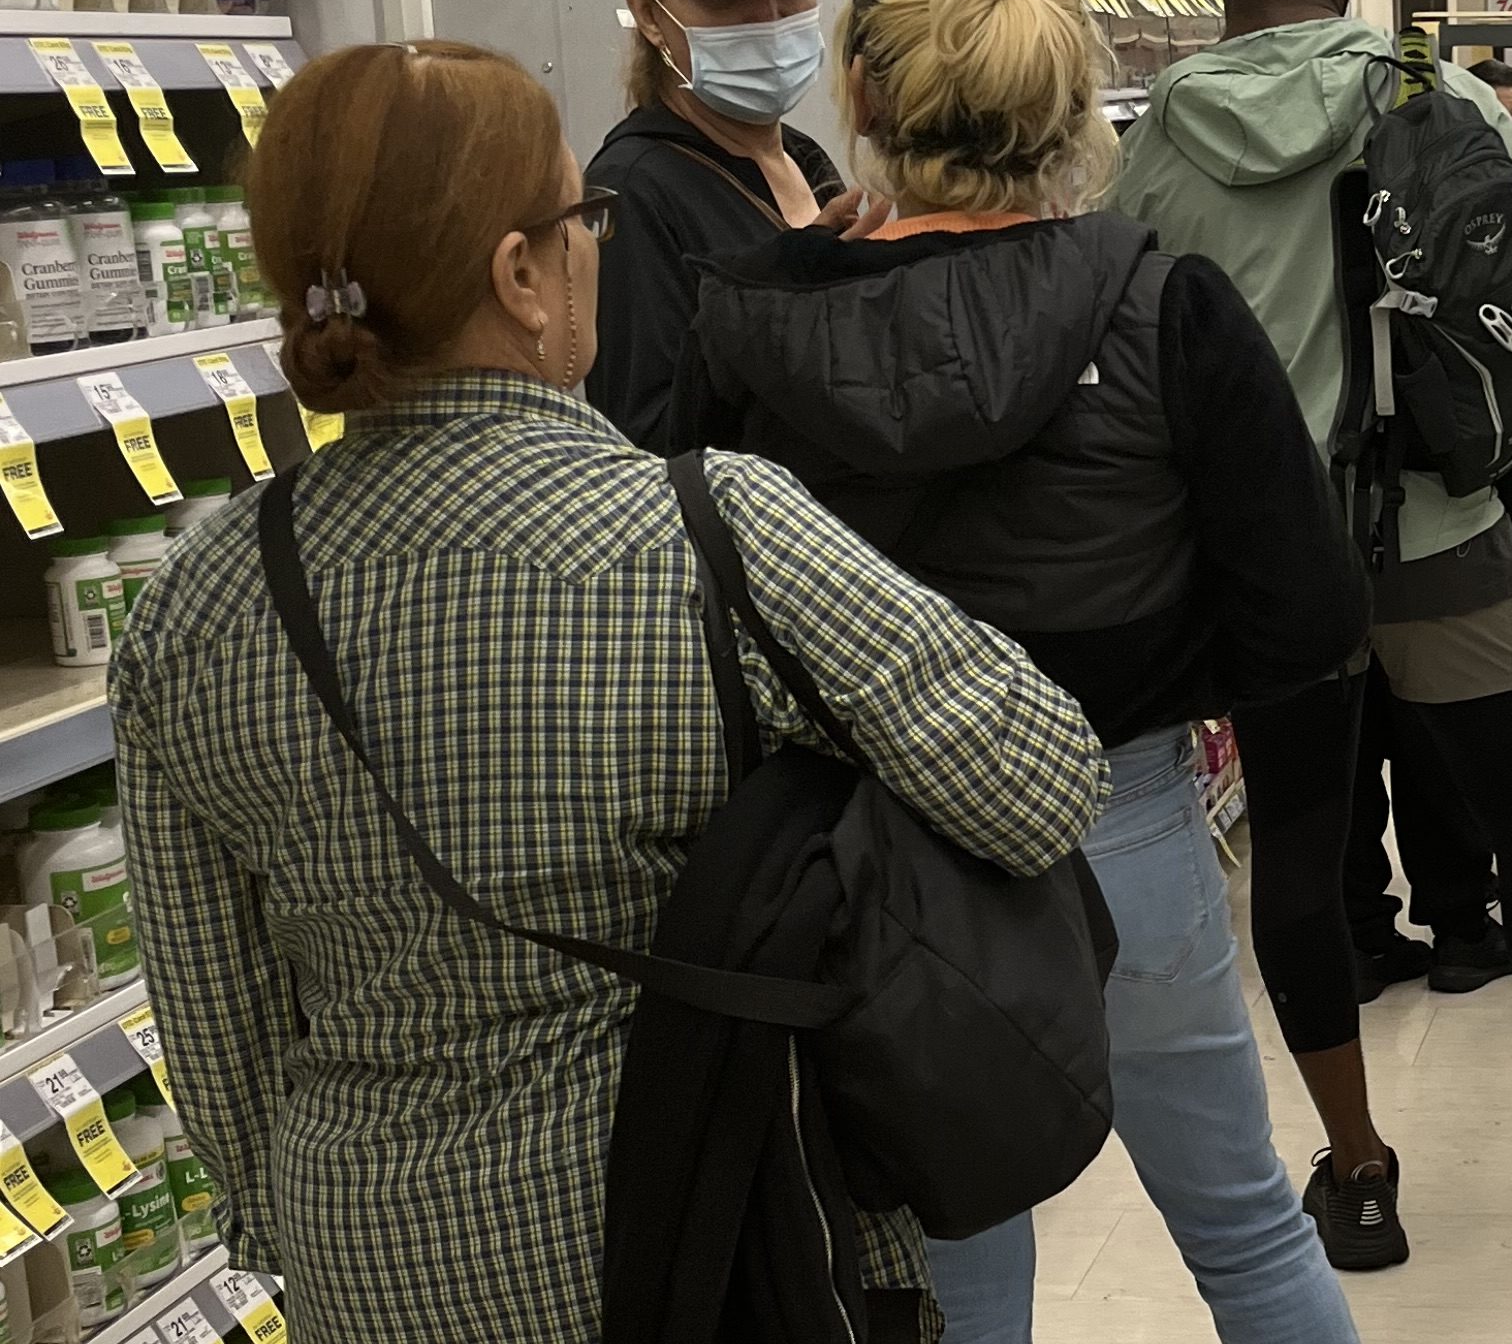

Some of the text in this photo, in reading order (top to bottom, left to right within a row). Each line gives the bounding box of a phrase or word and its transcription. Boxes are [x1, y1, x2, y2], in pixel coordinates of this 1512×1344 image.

[1464, 212, 1504, 236] OSPREY
[233, 413, 255, 429] FREE
[123, 434, 152, 453] FREE
[1, 461, 34, 481] FREE
[76, 1120, 105, 1147] FREE
[3, 1164, 30, 1191] FREE
[254, 1315, 283, 1341] FREE
